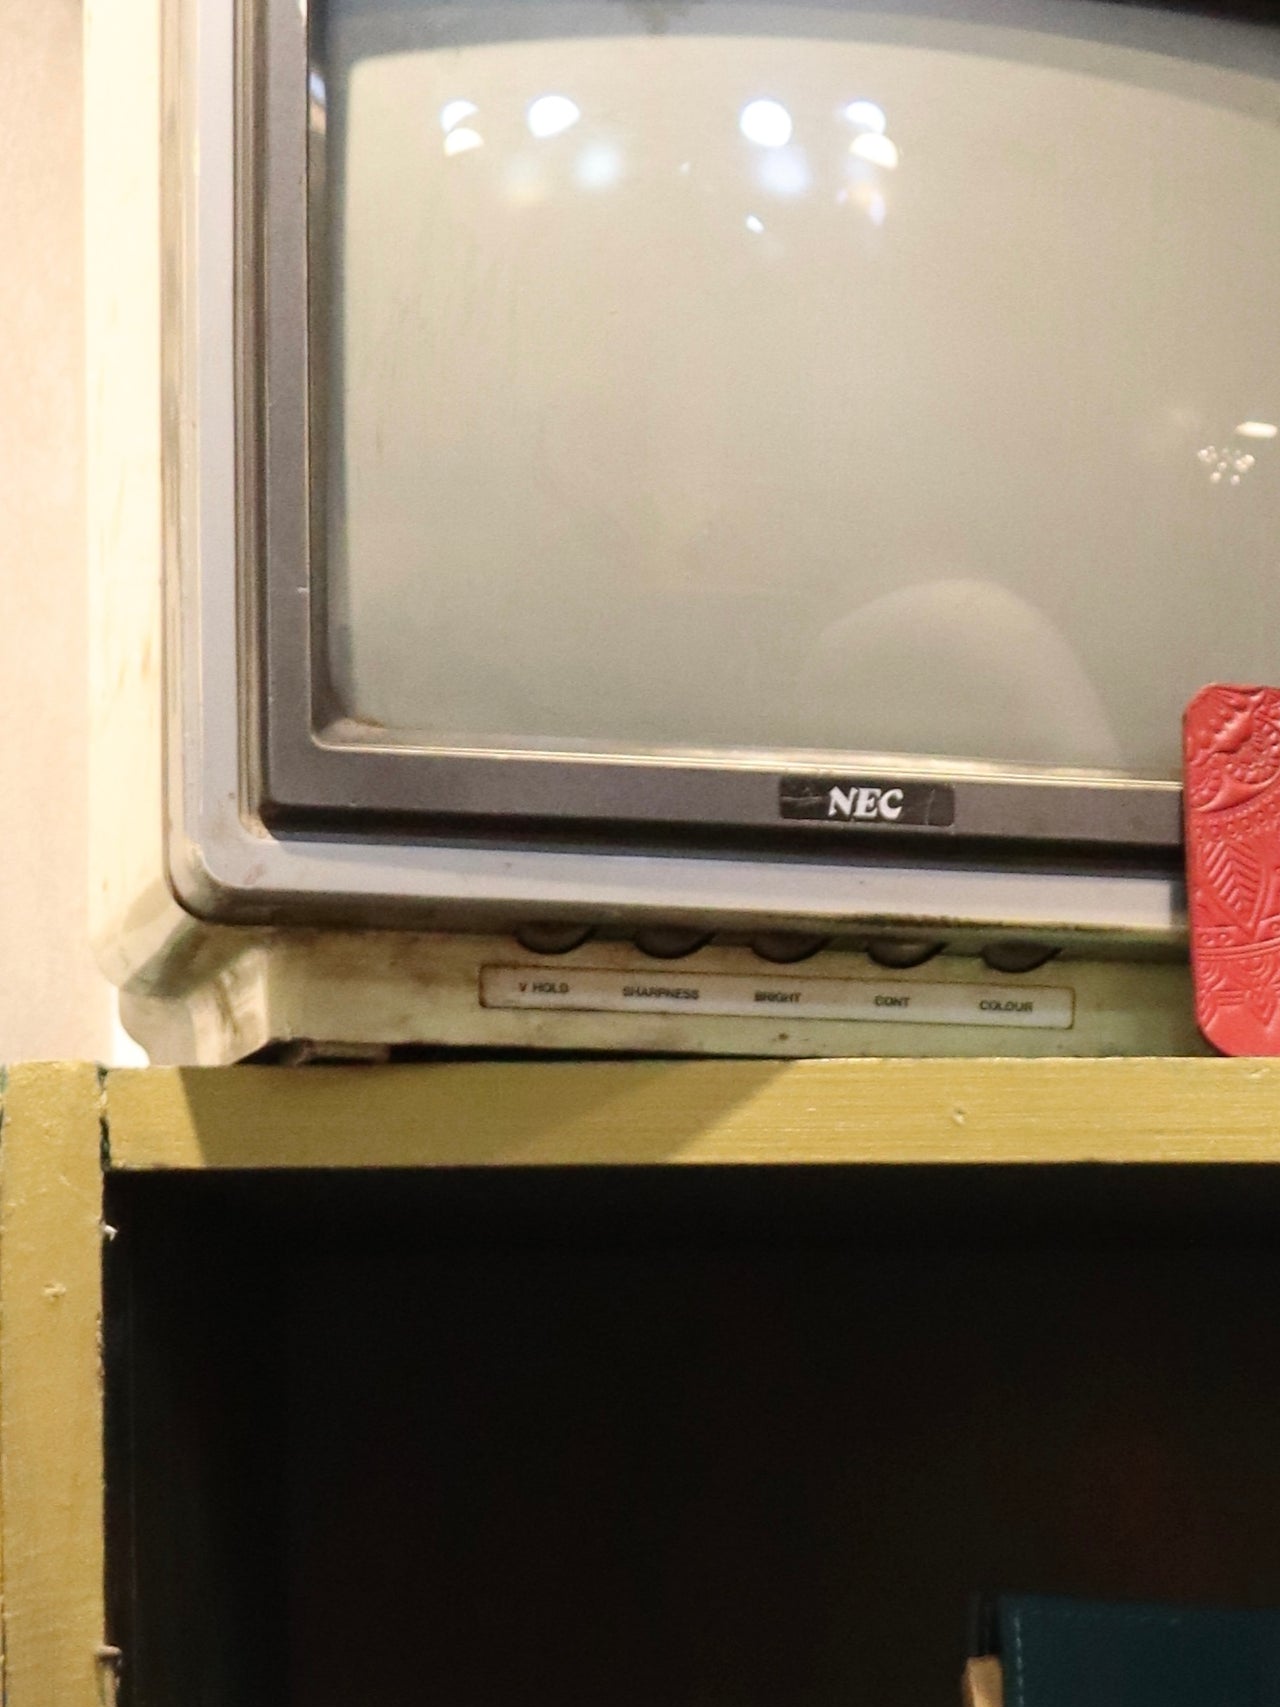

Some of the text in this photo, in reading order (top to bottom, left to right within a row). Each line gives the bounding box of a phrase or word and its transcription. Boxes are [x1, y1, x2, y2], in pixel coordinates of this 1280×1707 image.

[827, 786, 904, 821] NEC
[532, 982, 569, 995] HOLD
[623, 985, 700, 1001] SHARPNESS
[754, 989, 802, 1004] BRIGHT
[874, 995, 911, 1008] CONT
[979, 999, 1034, 1014] COLOUR
